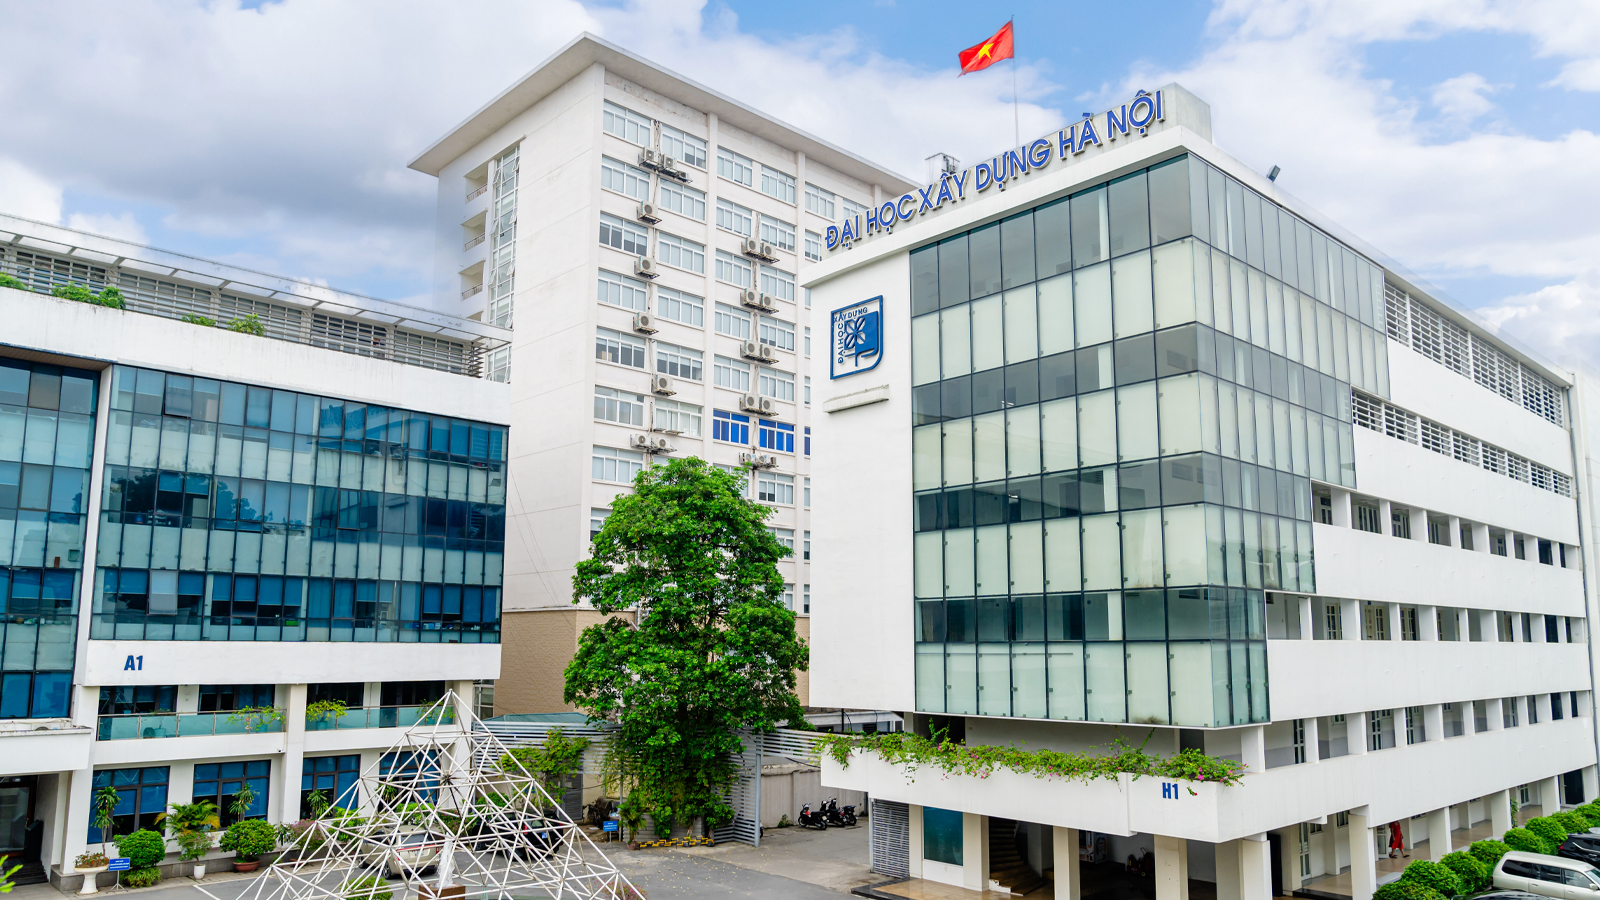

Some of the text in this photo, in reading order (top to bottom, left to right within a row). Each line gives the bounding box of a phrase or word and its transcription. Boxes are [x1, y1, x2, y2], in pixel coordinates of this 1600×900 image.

[825, 89, 1165, 250] ĐẠI HỌC XÂY DỰNG HÀ NỘI
[124, 655, 143, 671] A1
[1162, 782, 1179, 800] H1
